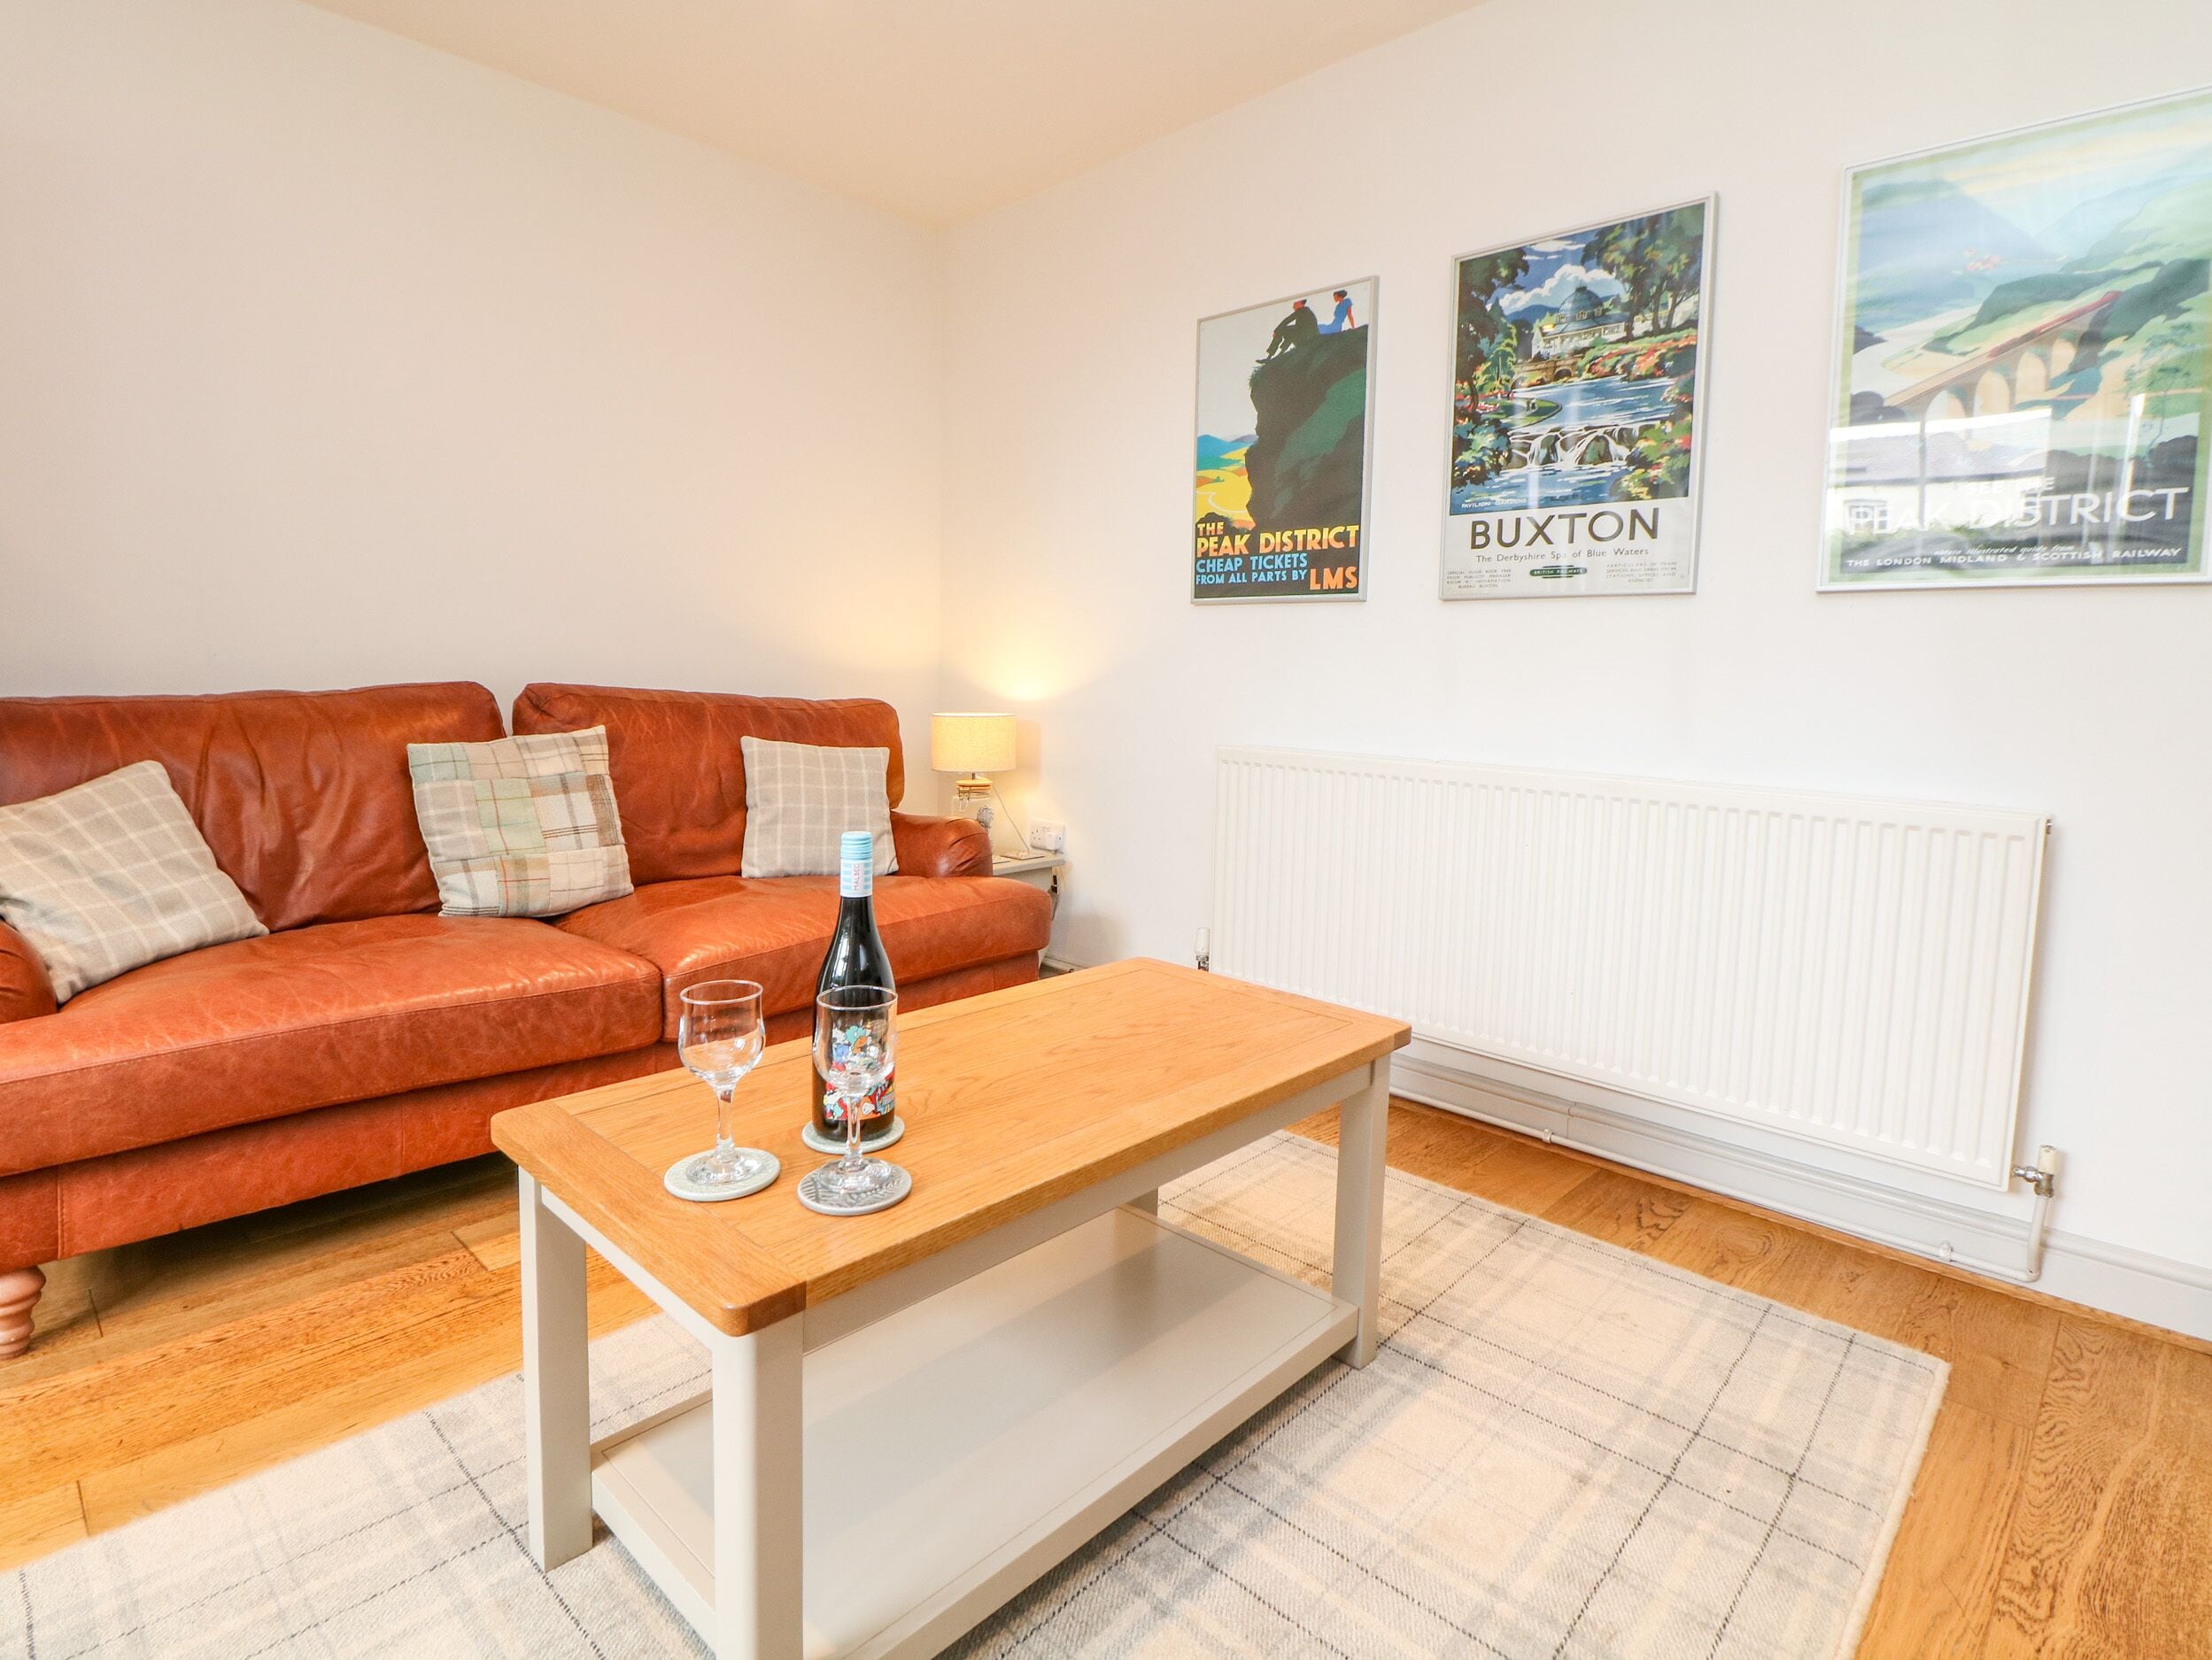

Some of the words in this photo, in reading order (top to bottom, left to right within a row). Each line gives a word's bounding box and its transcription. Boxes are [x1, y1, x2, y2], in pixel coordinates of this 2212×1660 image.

[1968, 487, 2190, 535] DISTRICT
[1197, 521, 1225, 537] THE
[1471, 507, 1659, 550] BUXTON
[1196, 534, 1250, 558] PEAK
[1259, 524, 1359, 554] DISTRICT
[2020, 545, 2047, 556] guide
[1195, 557, 1243, 574] CHEAP
[1250, 552, 1308, 571] TICKETS
[1476, 554, 1492, 563] The
[1497, 552, 1545, 564] Derbyshire
[1572, 550, 1582, 559] of
[1587, 549, 1607, 558] Blue
[1613, 547, 1650, 556] Waters
[1846, 559, 1871, 567] THE
[1876, 557, 1932, 567] LONDON
[1939, 553, 2008, 564] MIDLAND
[2032, 549, 2103, 561] SCOTTISH
[2112, 547, 2183, 559] RAILWAY
[1195, 574, 1225, 585] FROM
[1228, 573, 1248, 583] ALL
[1251, 570, 1287, 583] PARTS
[1292, 569, 1308, 581] BY
[1309, 567, 1357, 591] LMS
